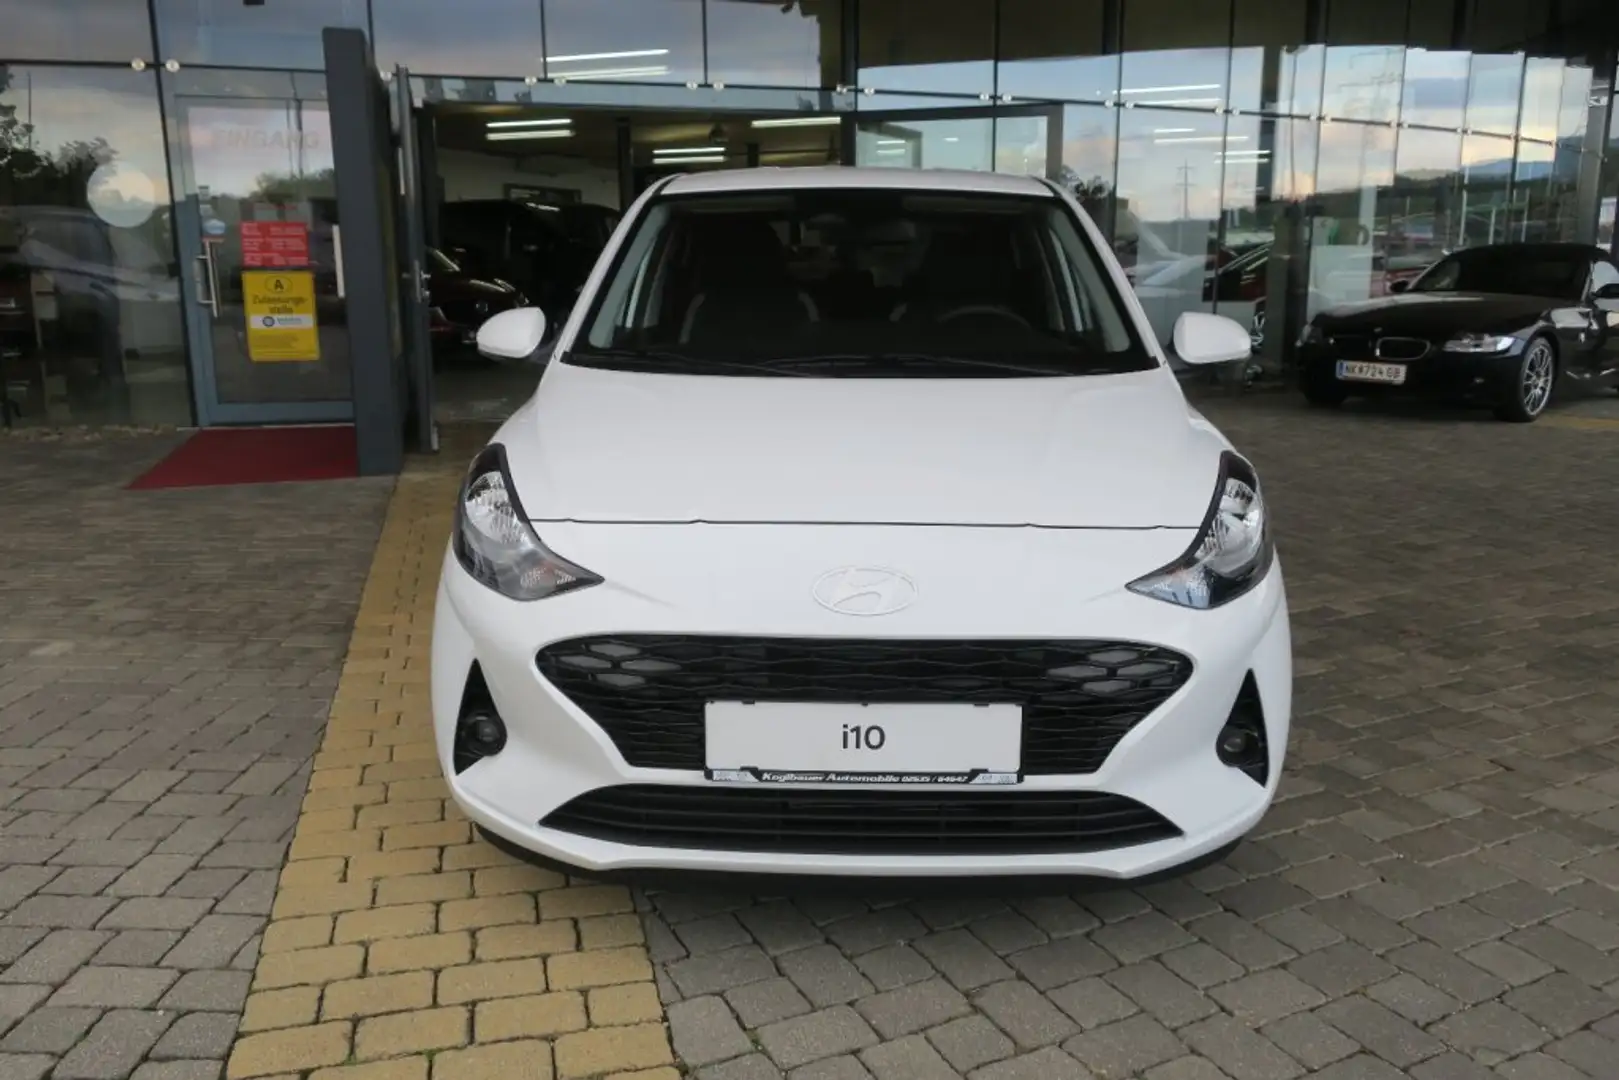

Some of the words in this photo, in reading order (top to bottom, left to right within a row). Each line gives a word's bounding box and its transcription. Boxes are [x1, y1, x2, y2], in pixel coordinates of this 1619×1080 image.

[274, 279, 285, 290] A
[842, 724, 886, 750] i10
[825, 772, 900, 784] Automobile
